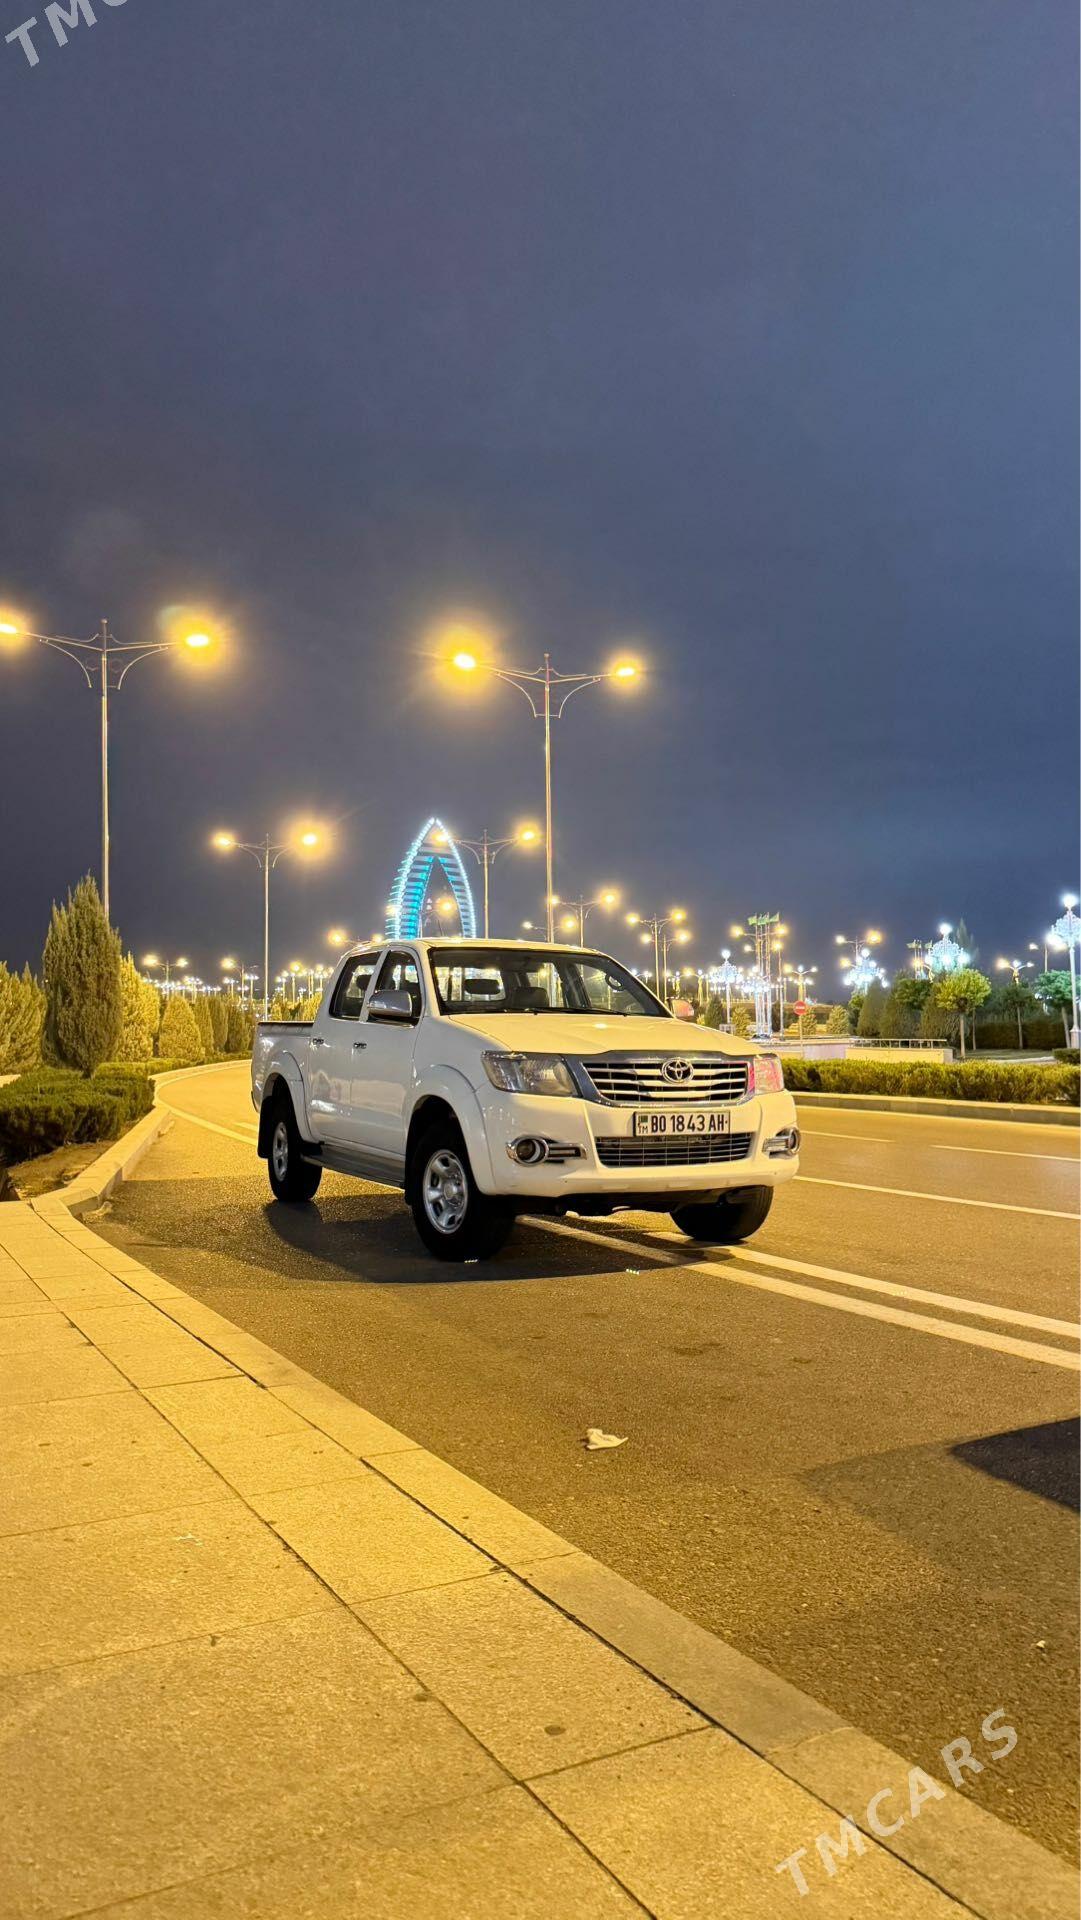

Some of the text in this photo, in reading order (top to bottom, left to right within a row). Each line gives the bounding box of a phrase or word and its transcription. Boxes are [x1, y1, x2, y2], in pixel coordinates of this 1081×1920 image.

[638, 1125, 648, 1134] TM
[670, 1114, 705, 1133] 1843
[709, 1114, 725, 1131] AH
